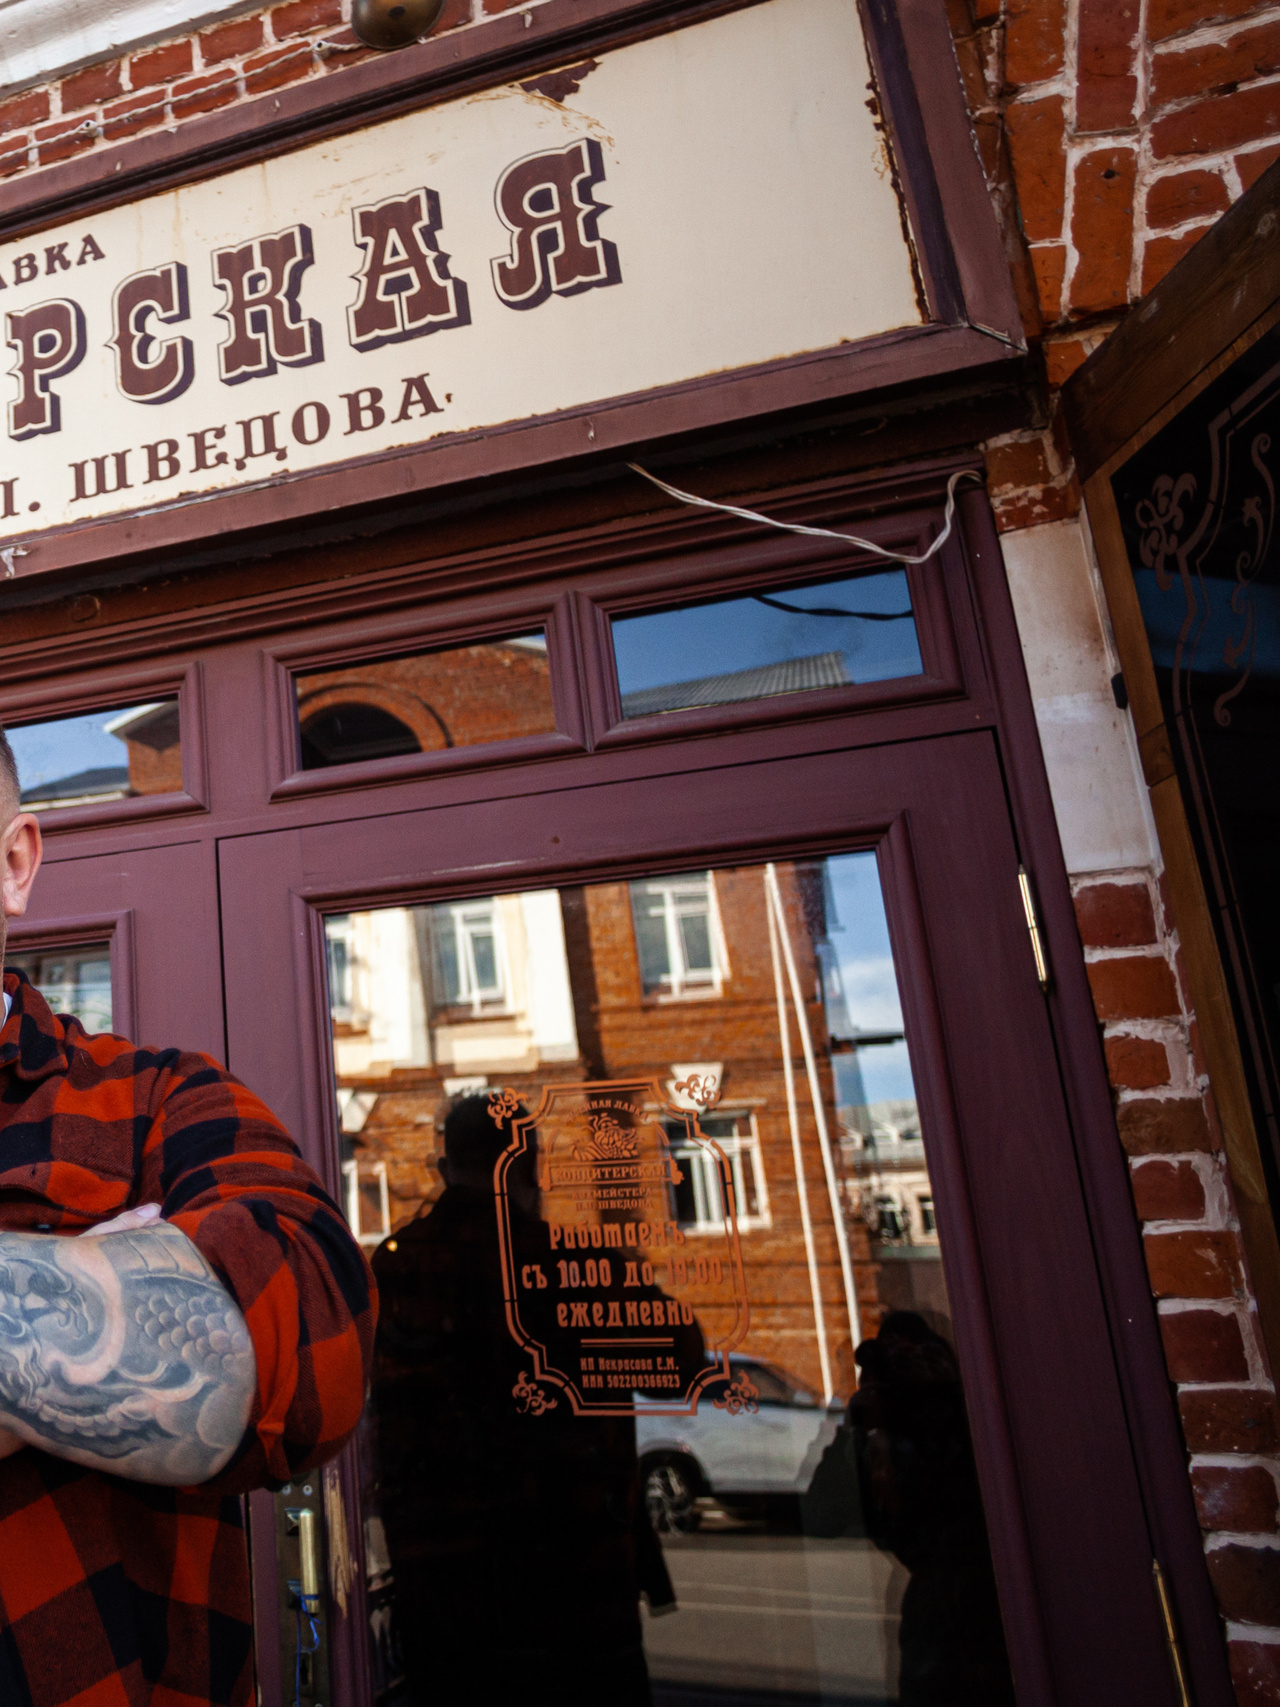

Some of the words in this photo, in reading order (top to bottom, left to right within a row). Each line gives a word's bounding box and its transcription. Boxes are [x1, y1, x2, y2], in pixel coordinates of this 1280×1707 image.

[548, 1220, 686, 1250] Работаемъ
[521, 1264, 548, 1289] съ
[556, 1258, 612, 1289] 10.00
[623, 1261, 655, 1288] до
[666, 1256, 724, 1287] 19.00
[557, 1300, 694, 1328] ежедневно
